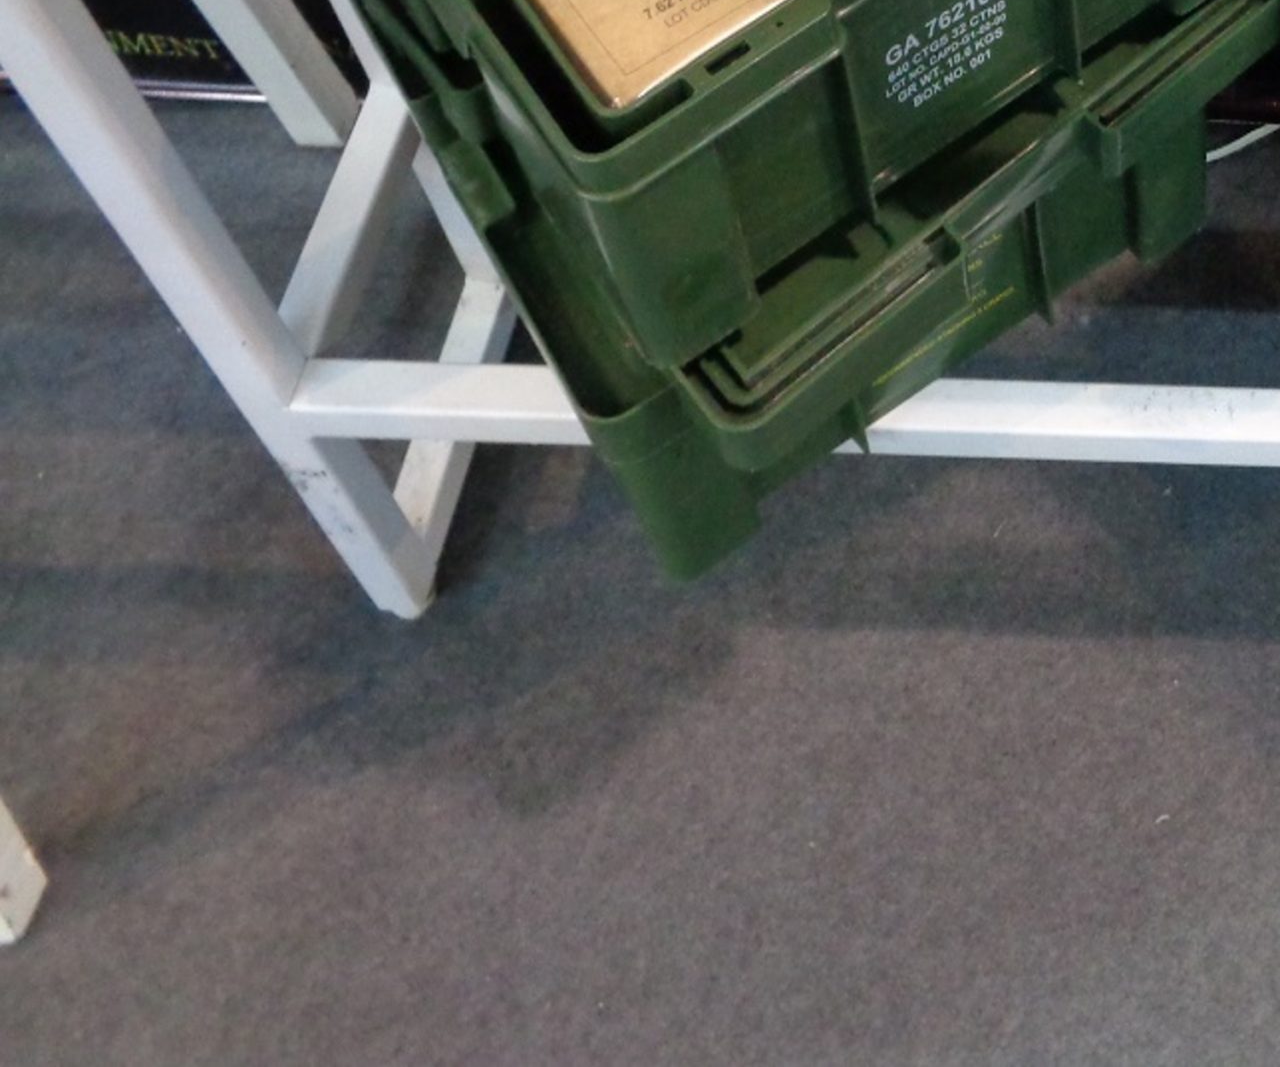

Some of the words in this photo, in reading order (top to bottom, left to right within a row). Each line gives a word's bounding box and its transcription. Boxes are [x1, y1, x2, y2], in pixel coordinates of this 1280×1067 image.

[663, 7, 689, 29] LOT
[912, 34, 949, 65] CTGS
[952, 22, 967, 39] 32
[969, 0, 1006, 27] CTNS
[886, 34, 920, 66] GA
[886, 76, 906, 98] LOT
[913, 80, 942, 108] BOX
[944, 66, 967, 86] NO.
[969, 48, 991, 69] 001
